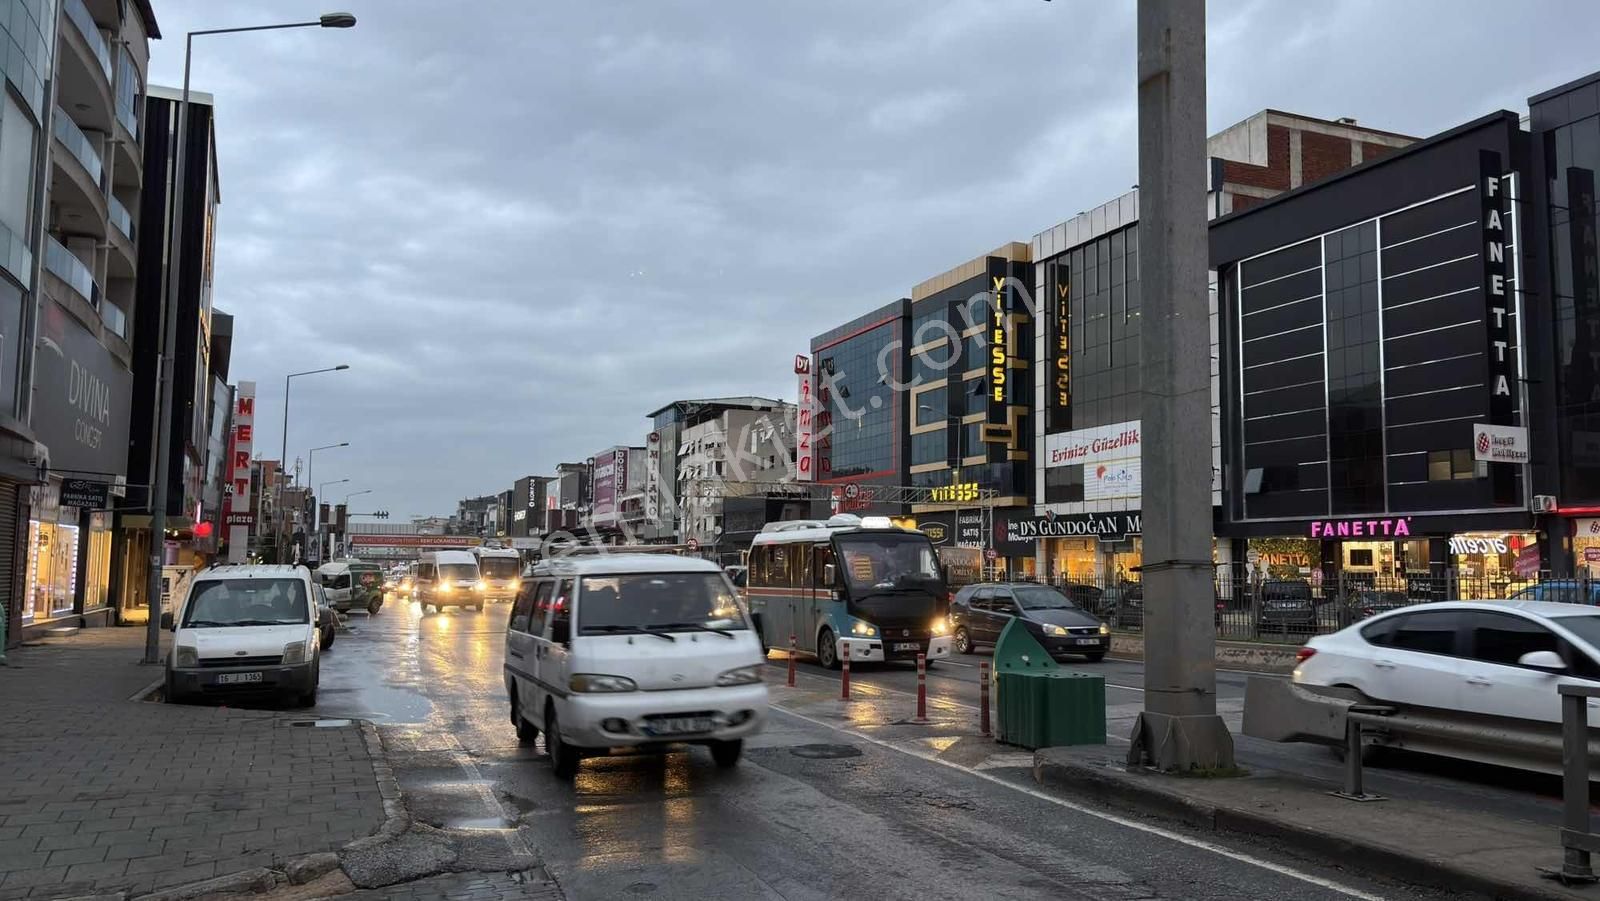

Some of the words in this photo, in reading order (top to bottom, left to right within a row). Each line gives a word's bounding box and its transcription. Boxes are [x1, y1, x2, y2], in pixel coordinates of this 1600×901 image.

[1488, 177, 1510, 396] FANETTA
[797, 356, 809, 372] by
[800, 379, 811, 472] imza
[235, 397, 253, 496] MERT
[1052, 443, 1089, 463] Evinize
[1092, 429, 1140, 453] Güzellik
[226, 516, 253, 524] plaza
[1126, 515, 1140, 532] M
[1311, 519, 1409, 537] FANETTA
